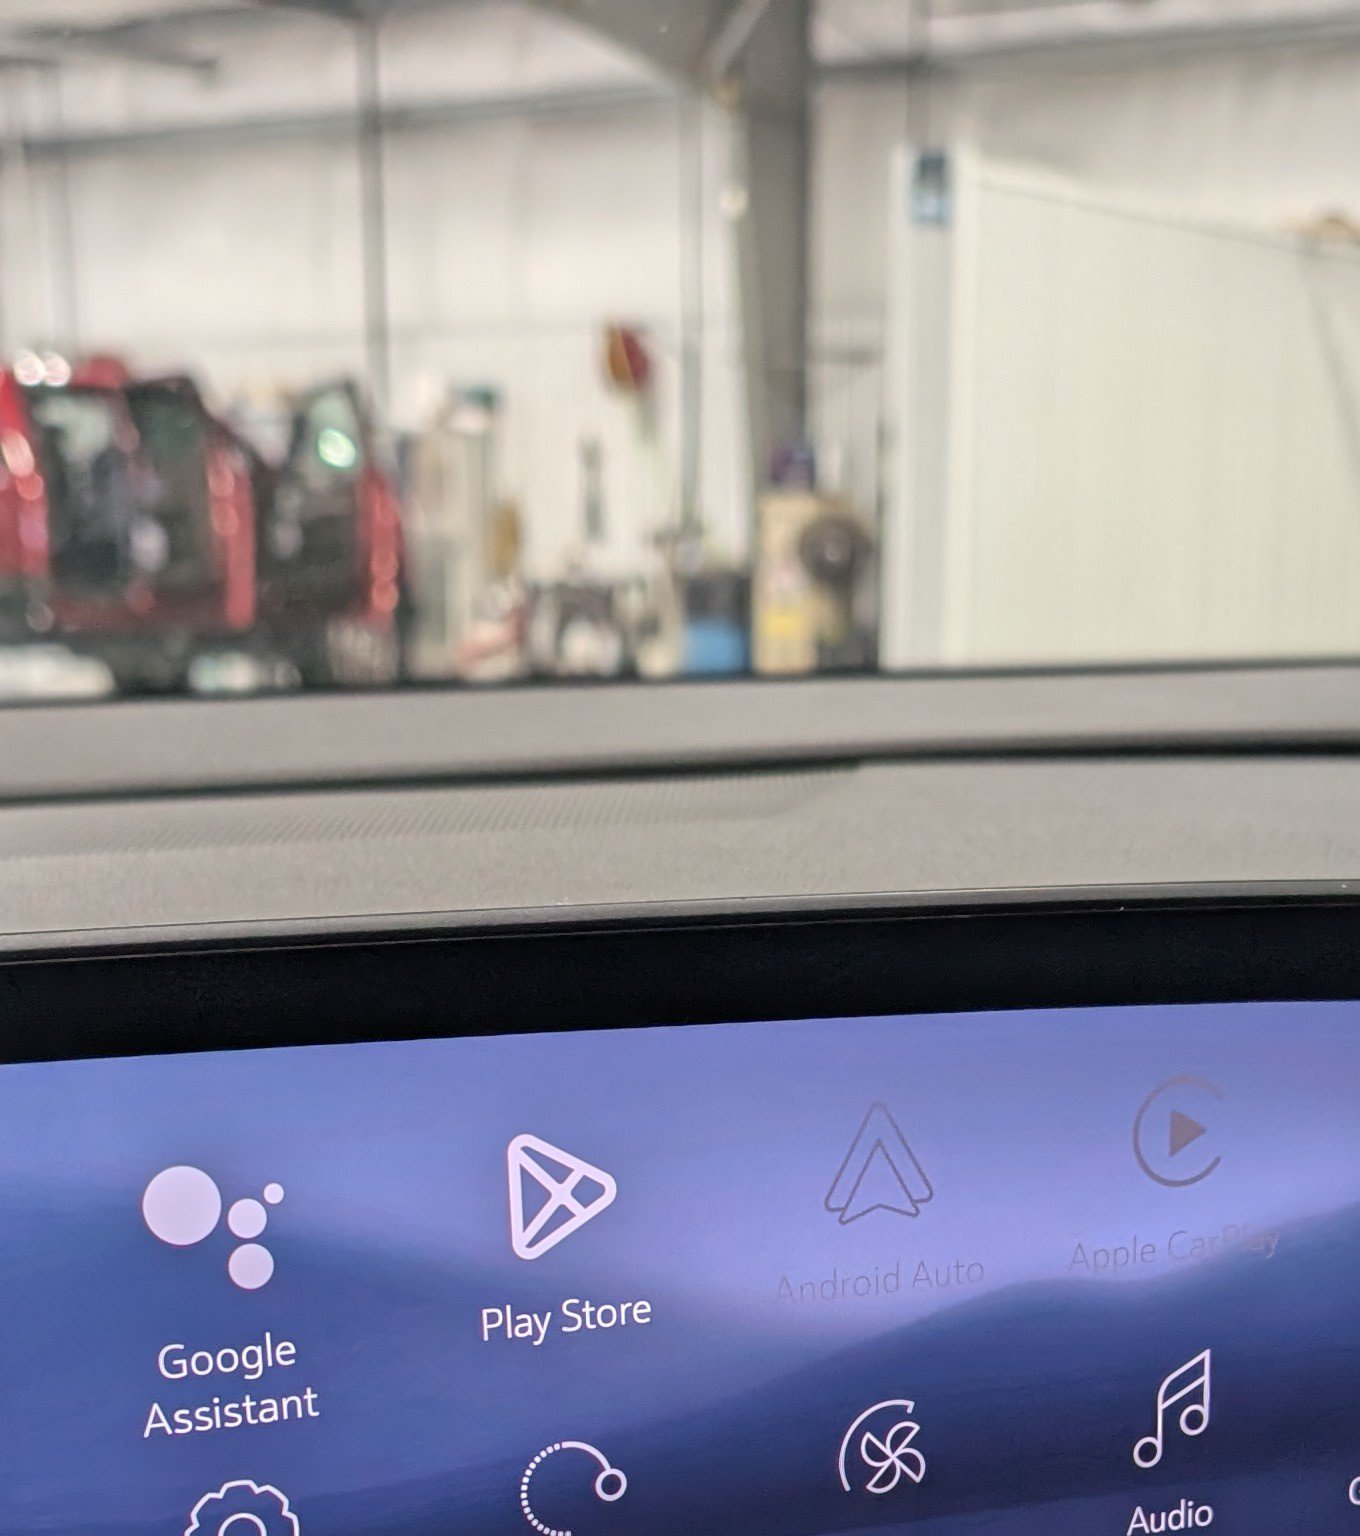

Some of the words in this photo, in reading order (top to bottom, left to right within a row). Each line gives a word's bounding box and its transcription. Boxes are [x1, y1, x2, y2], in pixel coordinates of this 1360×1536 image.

[1068, 1235, 1156, 1274] Apple
[776, 1261, 900, 1302] Android
[912, 1259, 985, 1288] Auto
[481, 1303, 550, 1344] Play
[561, 1297, 652, 1331] Store
[157, 1334, 296, 1388] Google
[143, 1386, 320, 1437] Assistant
[1126, 1499, 1214, 1536] Audio
